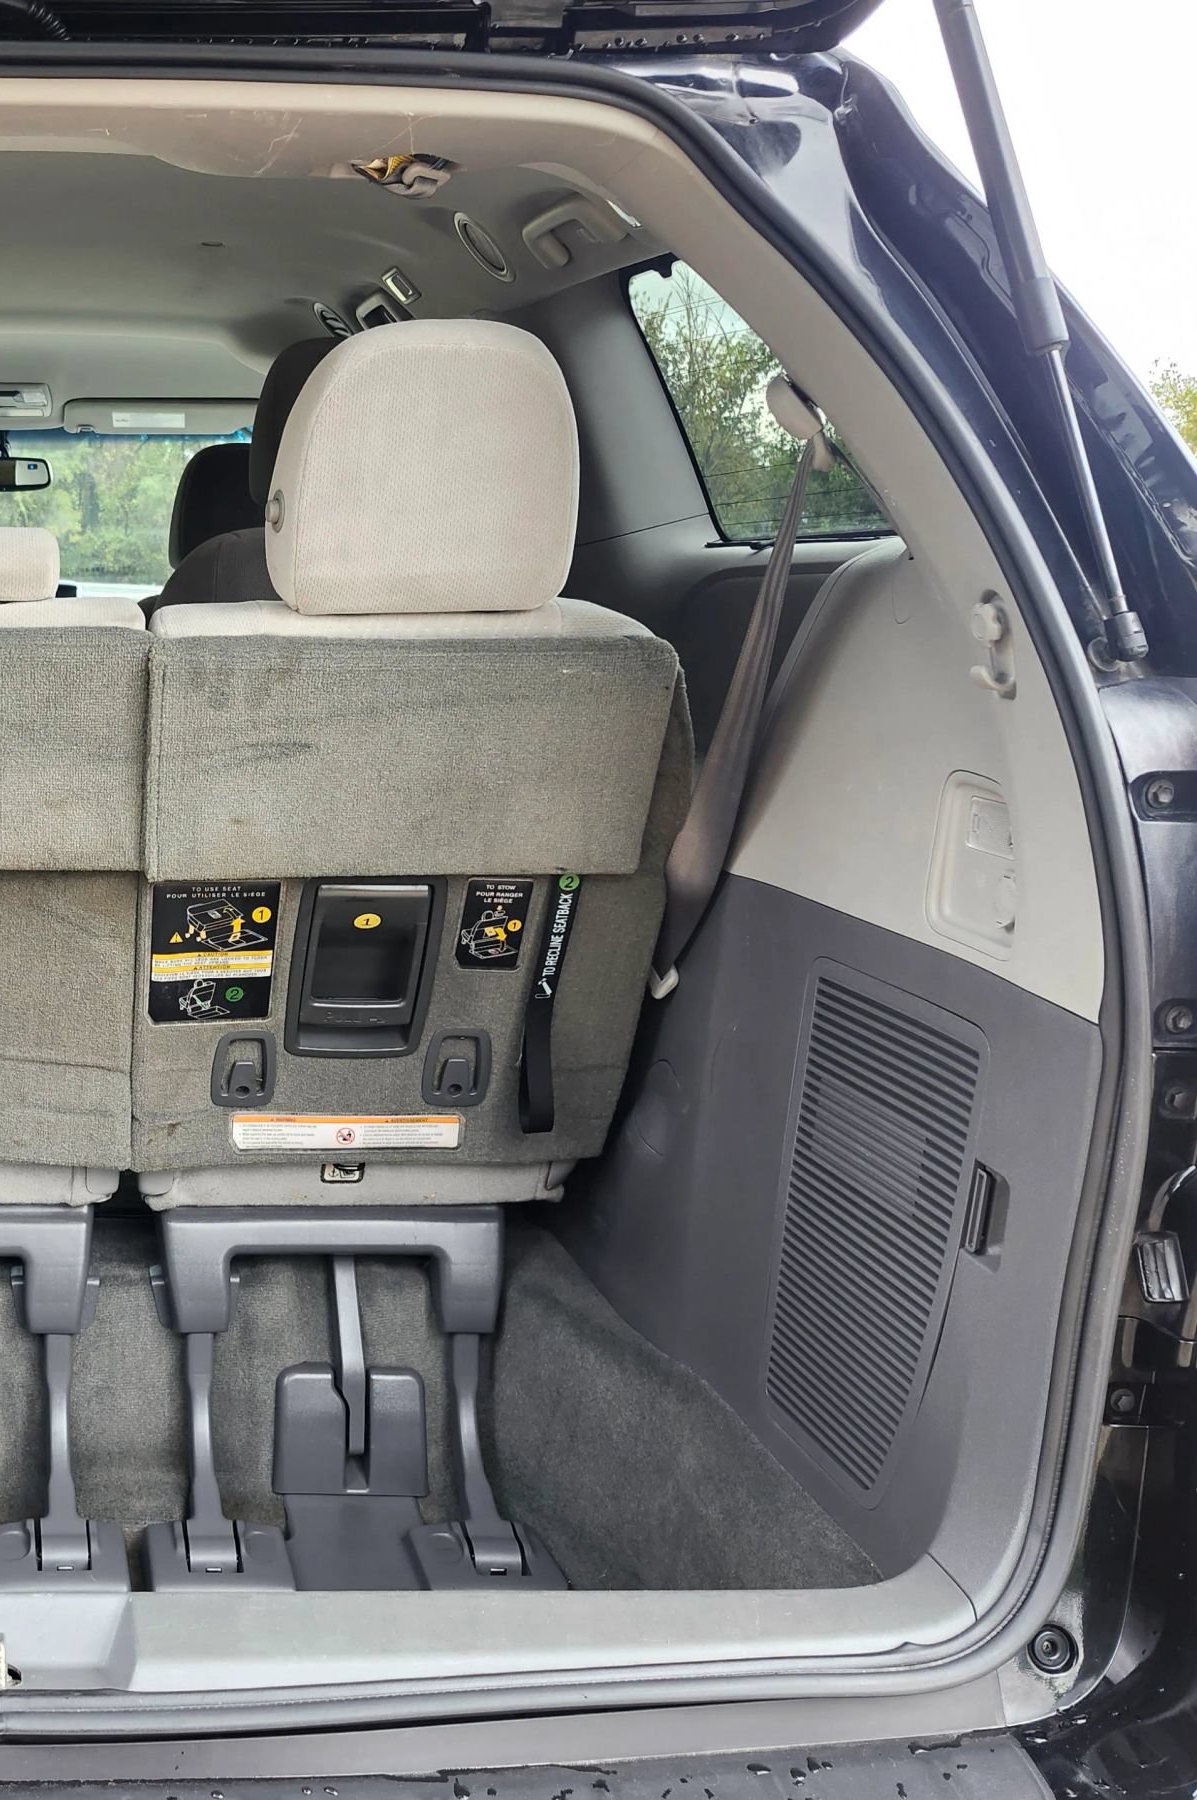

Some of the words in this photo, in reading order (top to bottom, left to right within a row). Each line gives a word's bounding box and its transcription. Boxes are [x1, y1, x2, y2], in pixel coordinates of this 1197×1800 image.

[552, 892, 574, 934] SEATBACK
[545, 934, 564, 966] RECLINE
[542, 966, 556, 977] TO
